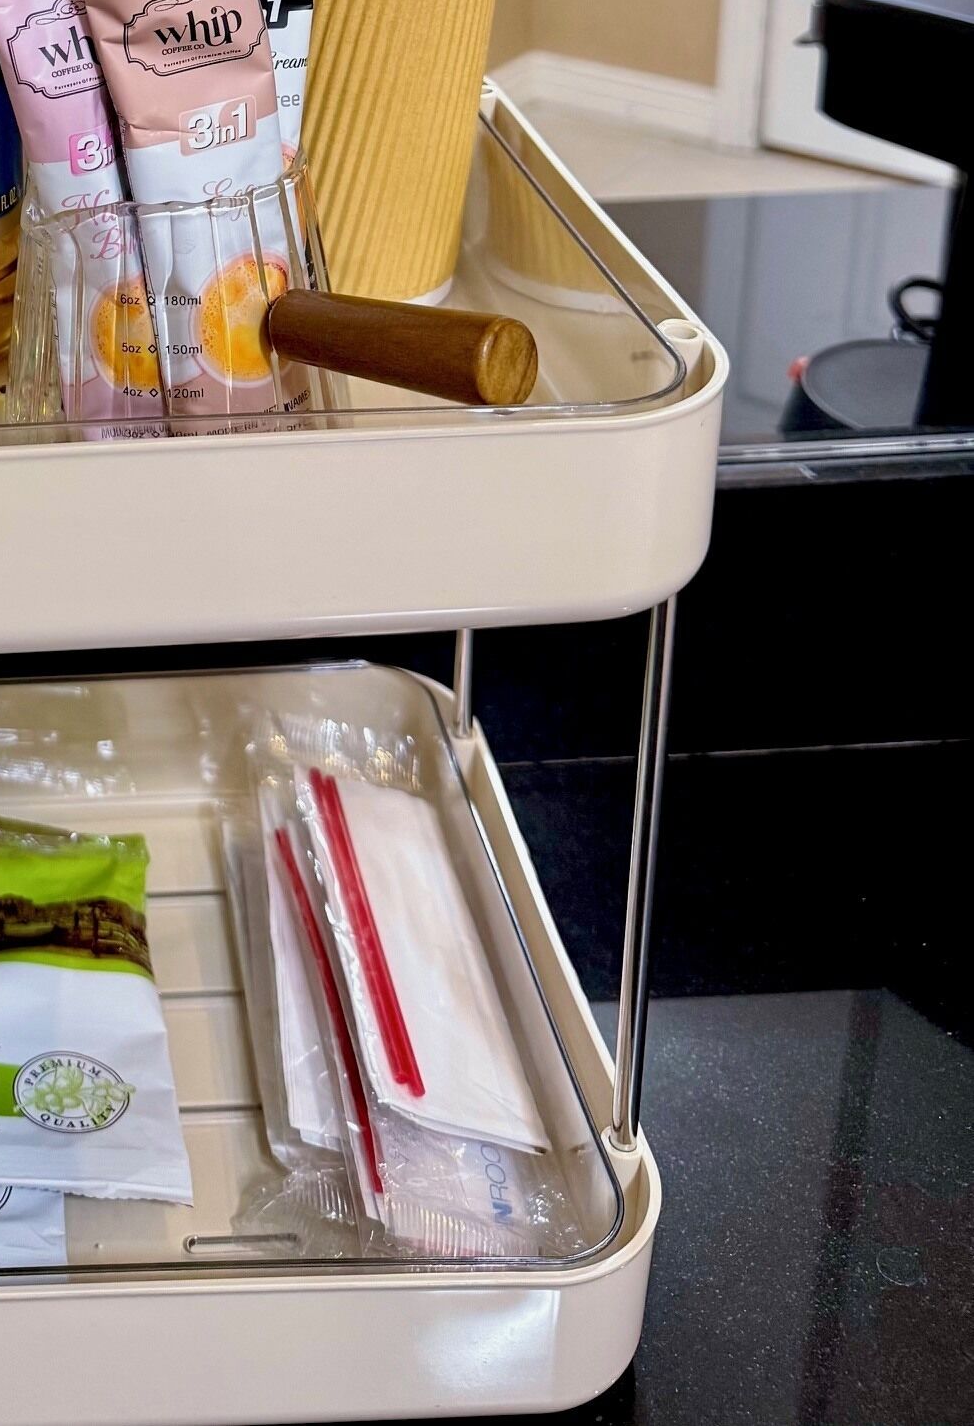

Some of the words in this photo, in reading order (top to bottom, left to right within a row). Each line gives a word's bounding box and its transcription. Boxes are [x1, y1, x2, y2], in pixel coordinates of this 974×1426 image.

[153, 5, 243, 47] whip
[38, 25, 101, 68] wh
[161, 44, 193, 56] COFFEE
[51, 64, 83, 78] COFFEE
[82, 62, 94, 70] CO
[276, 92, 300, 108] ree
[187, 102, 248, 151] 3in1
[77, 133, 115, 172] 3in
[120, 293, 141, 306] 6oz
[164, 295, 202, 306] 180ml
[122, 342, 142, 354] 5oz
[165, 344, 203, 355] 150ml
[123, 386, 144, 397] 4oz
[166, 388, 204, 399] 120ml
[24, 1058, 102, 1086] PREMIUM
[40, 1103, 116, 1129] QUALITY
